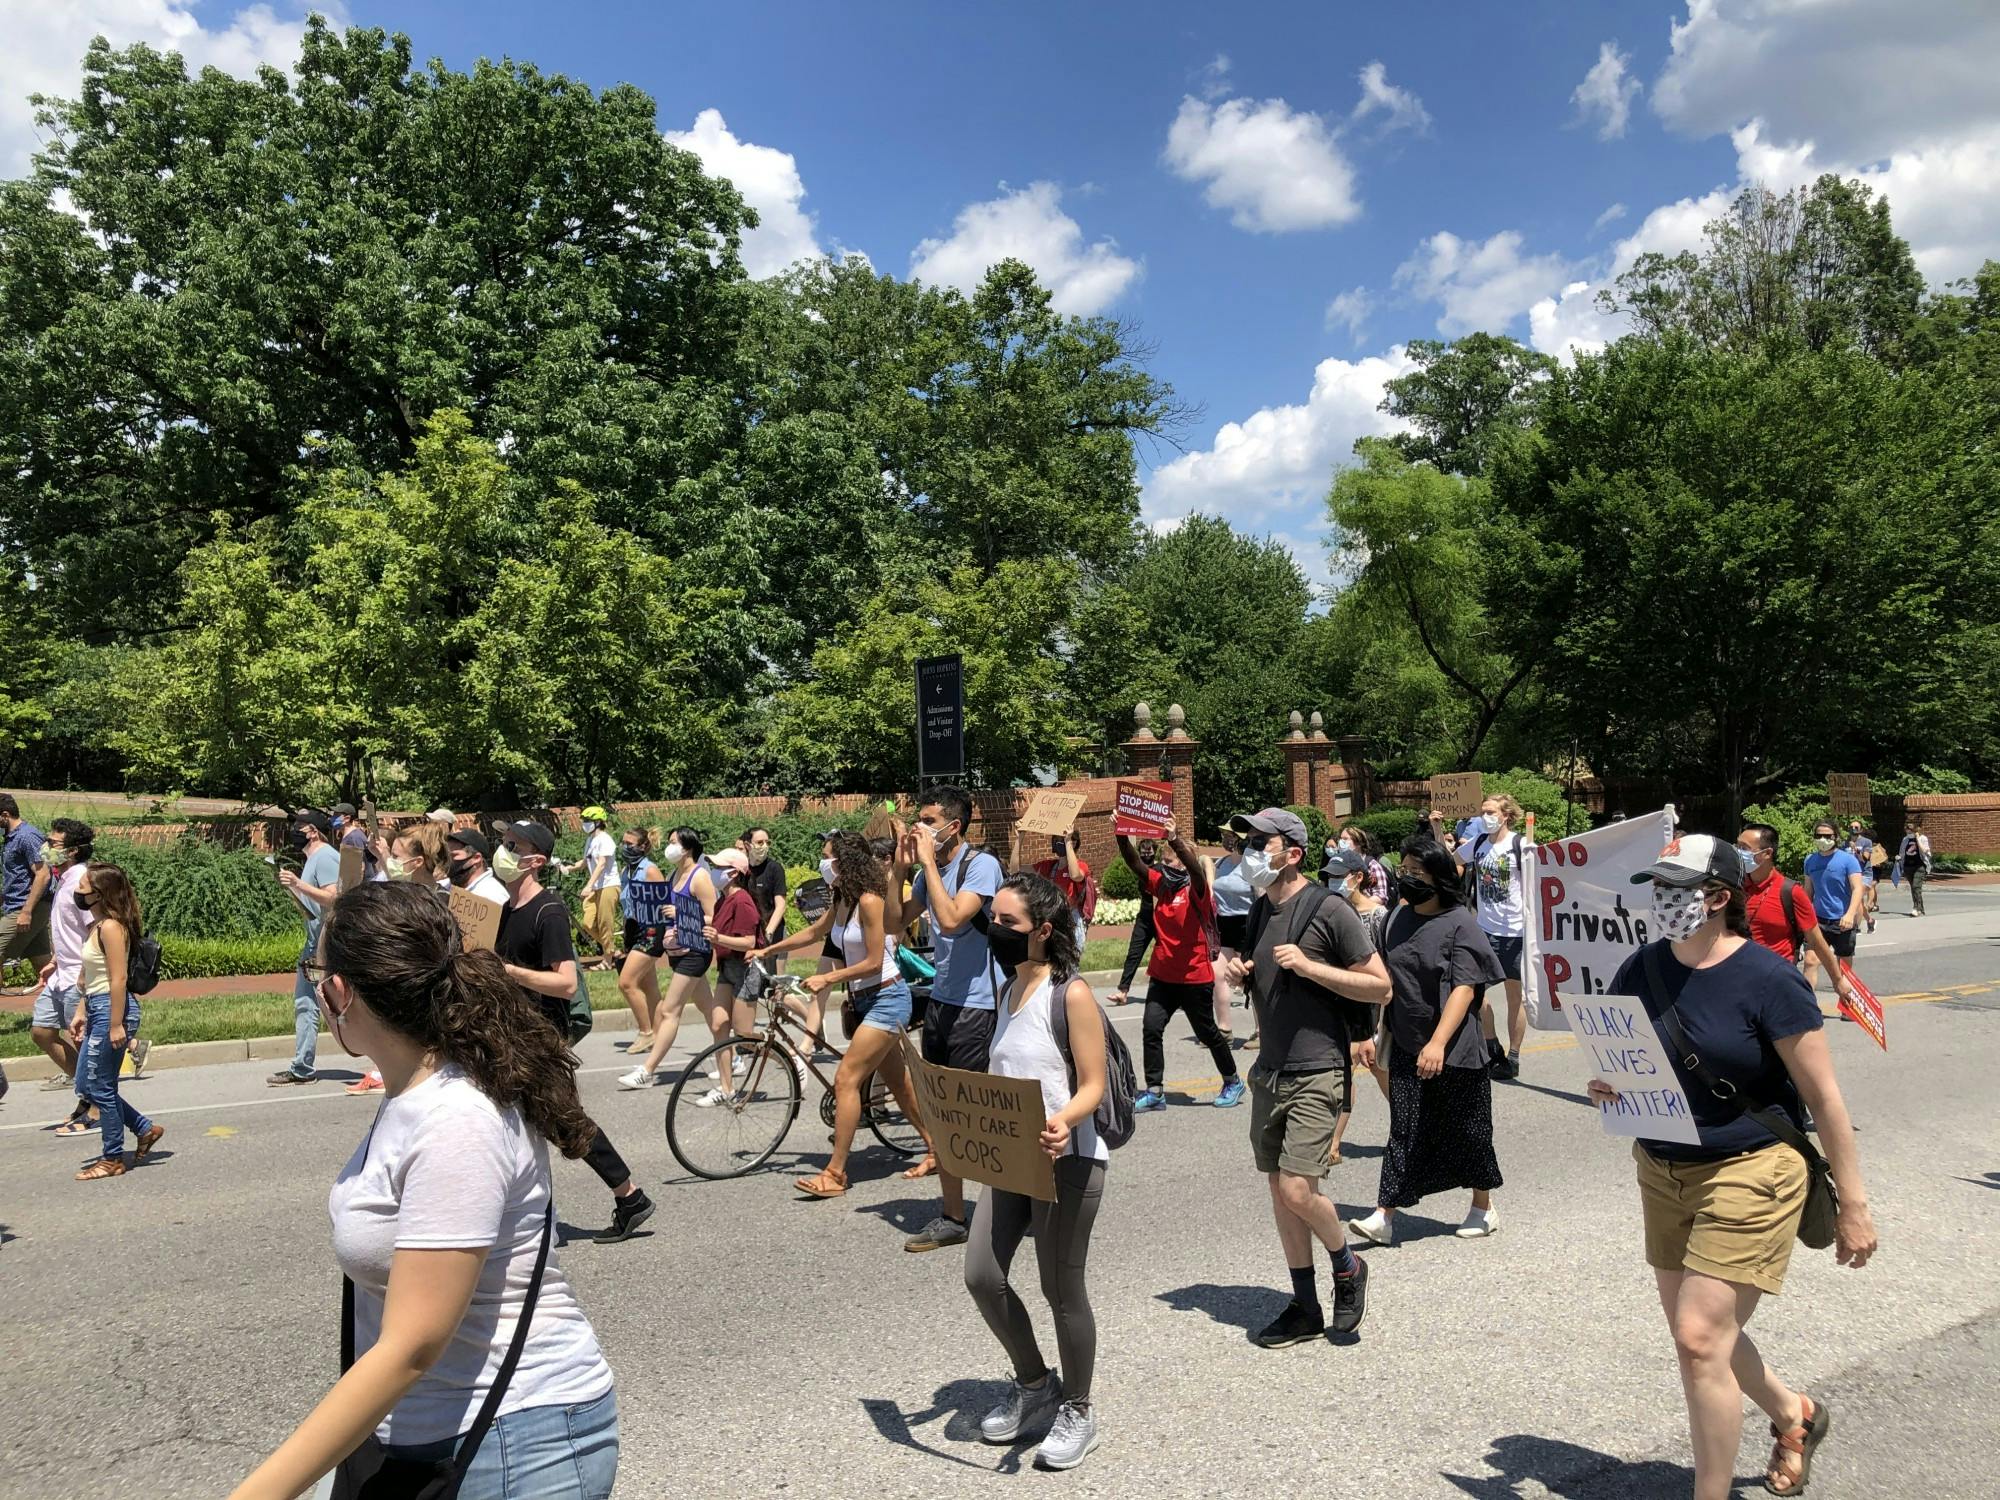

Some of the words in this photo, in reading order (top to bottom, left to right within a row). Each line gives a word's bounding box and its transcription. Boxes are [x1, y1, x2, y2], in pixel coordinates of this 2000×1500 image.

[936, 663, 957, 674] HOPKINS
[927, 705, 953, 714] Admissions
[928, 717, 936, 726] and
[936, 716, 953, 726] Visitor
[929, 728, 952, 740] Drop-Off
[1120, 785, 1134, 795] HEY
[1134, 788, 1159, 801] HOPKINS
[1434, 791, 1459, 803] ARM
[1118, 805, 1141, 816] PATIENTS
[1119, 793, 1142, 808] STOP
[1142, 799, 1169, 815] SUING
[1436, 803, 1477, 815] HOPKINS
[1038, 809, 1061, 820] WITH
[1027, 819, 1049, 830] BPD
[630, 883, 669, 901] JHU
[450, 892, 489, 922] DEFUND
[1540, 876, 1648, 945] Private
[1573, 1003, 1650, 1039] BLACK
[1591, 1044, 1657, 1075] LIVES
[957, 1082, 1022, 1112] ALUMNI
[1602, 1088, 1689, 1120] MATTER!
[980, 1116, 1021, 1138] CARE
[950, 1133, 1004, 1173] COPS
